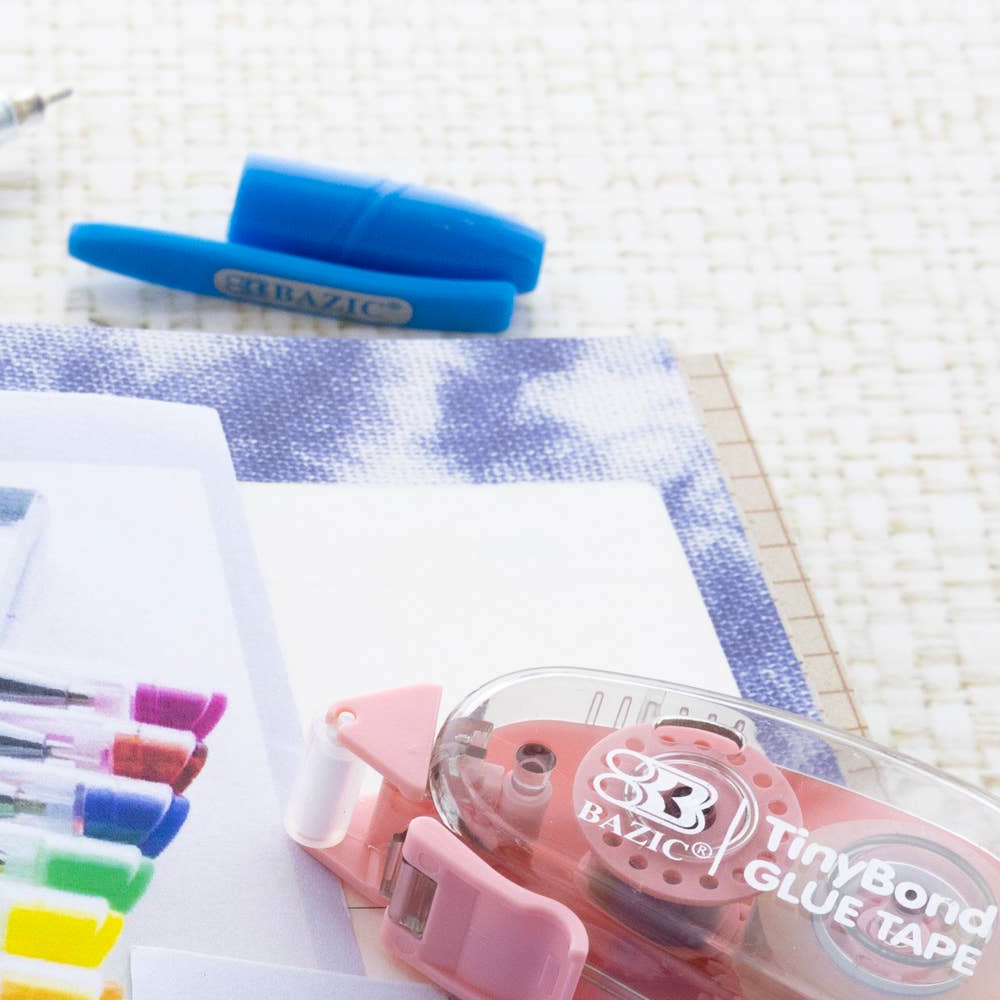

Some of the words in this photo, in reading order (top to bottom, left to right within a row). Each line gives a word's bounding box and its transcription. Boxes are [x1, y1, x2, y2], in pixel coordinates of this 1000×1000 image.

[743, 859, 864, 928] GLUE
[874, 909, 982, 977] TAPE
[765, 815, 998, 945] TinyBond
